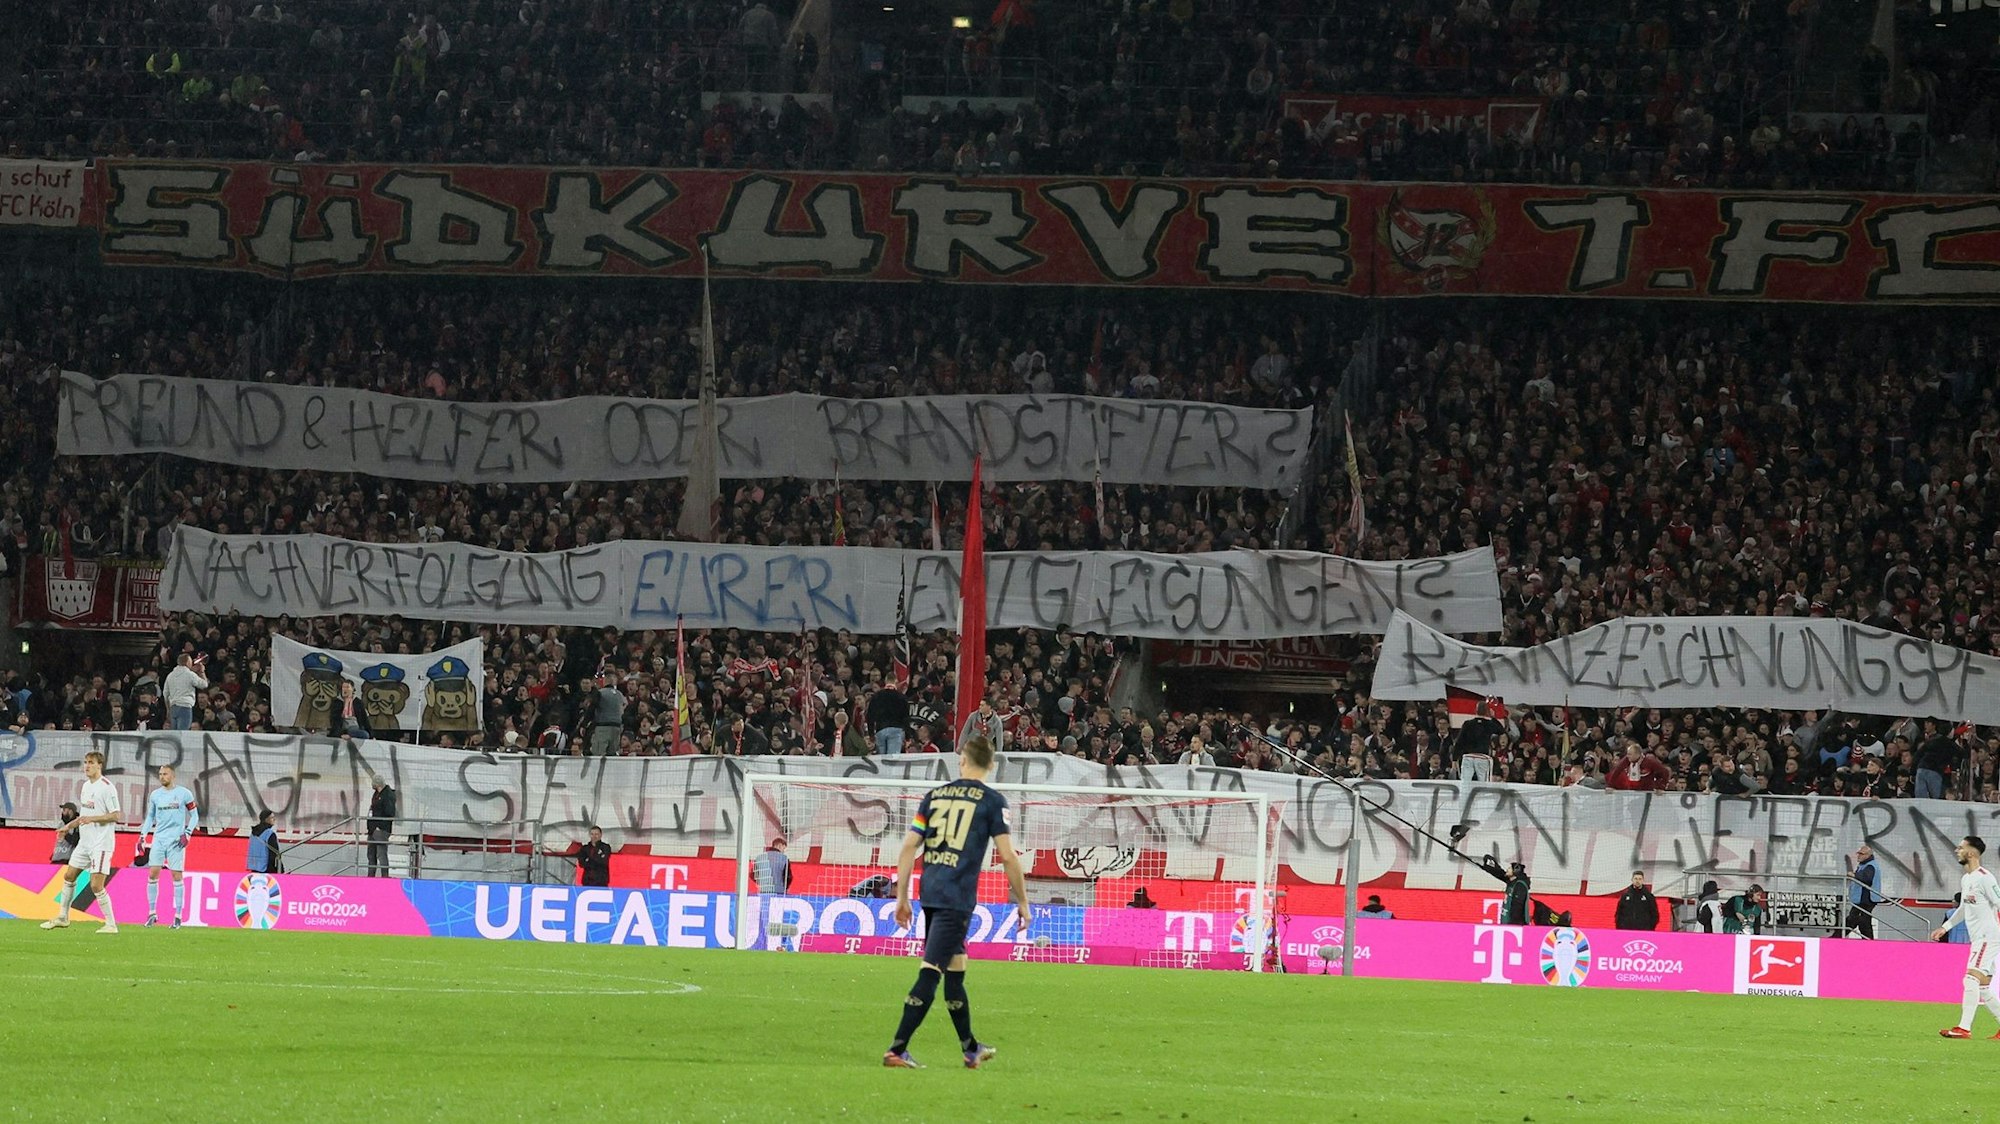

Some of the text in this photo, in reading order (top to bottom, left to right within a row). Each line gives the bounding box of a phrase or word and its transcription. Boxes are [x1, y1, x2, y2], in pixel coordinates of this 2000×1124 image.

[11, 164, 72, 188] schuf
[0, 194, 75, 219] FC Köln
[104, 164, 1352, 288] SÜDKURVE
[58, 376, 287, 455] FREUND
[302, 395, 328, 449] &
[342, 400, 563, 475] HELFER
[604, 400, 763, 469] ODER
[169, 530, 607, 611] NACHVERFOLGUNG
[630, 551, 861, 627] EURER
[931, 785, 966, 798] MAINZ
[924, 799, 978, 852] 30
[313, 886, 342, 900] UEFA
[288, 901, 367, 918] EURO2024
[304, 916, 349, 927] GERMANY
[1313, 928, 1344, 941] UEFA
[1624, 940, 1656, 956] UEFA
[1597, 956, 1684, 974] EURO2024
[1615, 973, 1663, 983] GERMANY
[1747, 987, 1804, 998] BUNDESLIGA
